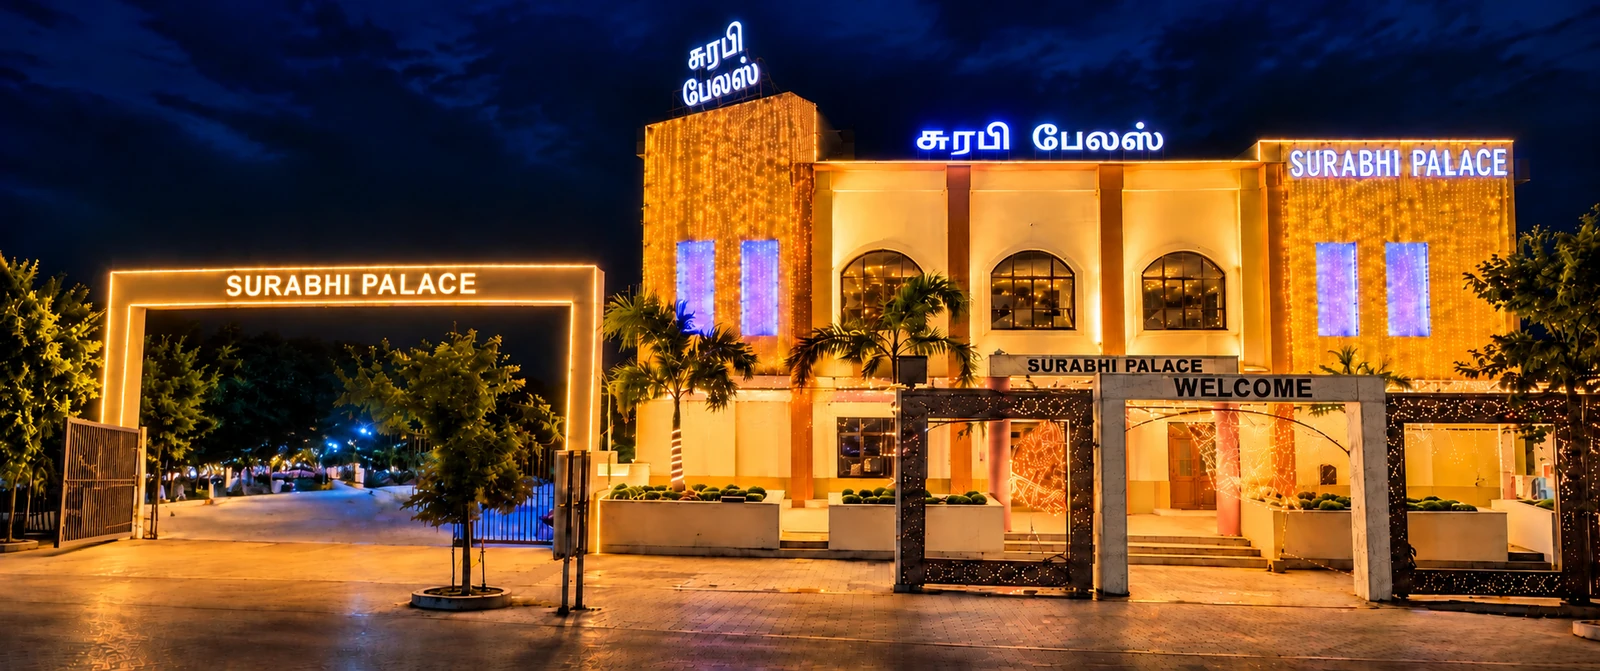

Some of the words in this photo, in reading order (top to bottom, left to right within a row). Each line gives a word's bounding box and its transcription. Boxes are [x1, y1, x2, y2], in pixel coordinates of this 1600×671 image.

[688, 20, 743, 71] சுரபி
[682, 56, 759, 106] பேலஸ்
[916, 121, 1010, 155] சுரபி
[1032, 121, 1164, 151] பேலஸ்
[1290, 149, 1399, 177] SURABHI
[1412, 148, 1508, 177] PALACE
[226, 274, 350, 297] SURABHI
[361, 272, 476, 295] PALACE
[1027, 358, 1117, 373] SURABHI
[1125, 358, 1203, 373] PALACE
[1173, 377, 1313, 398] WELCOME
